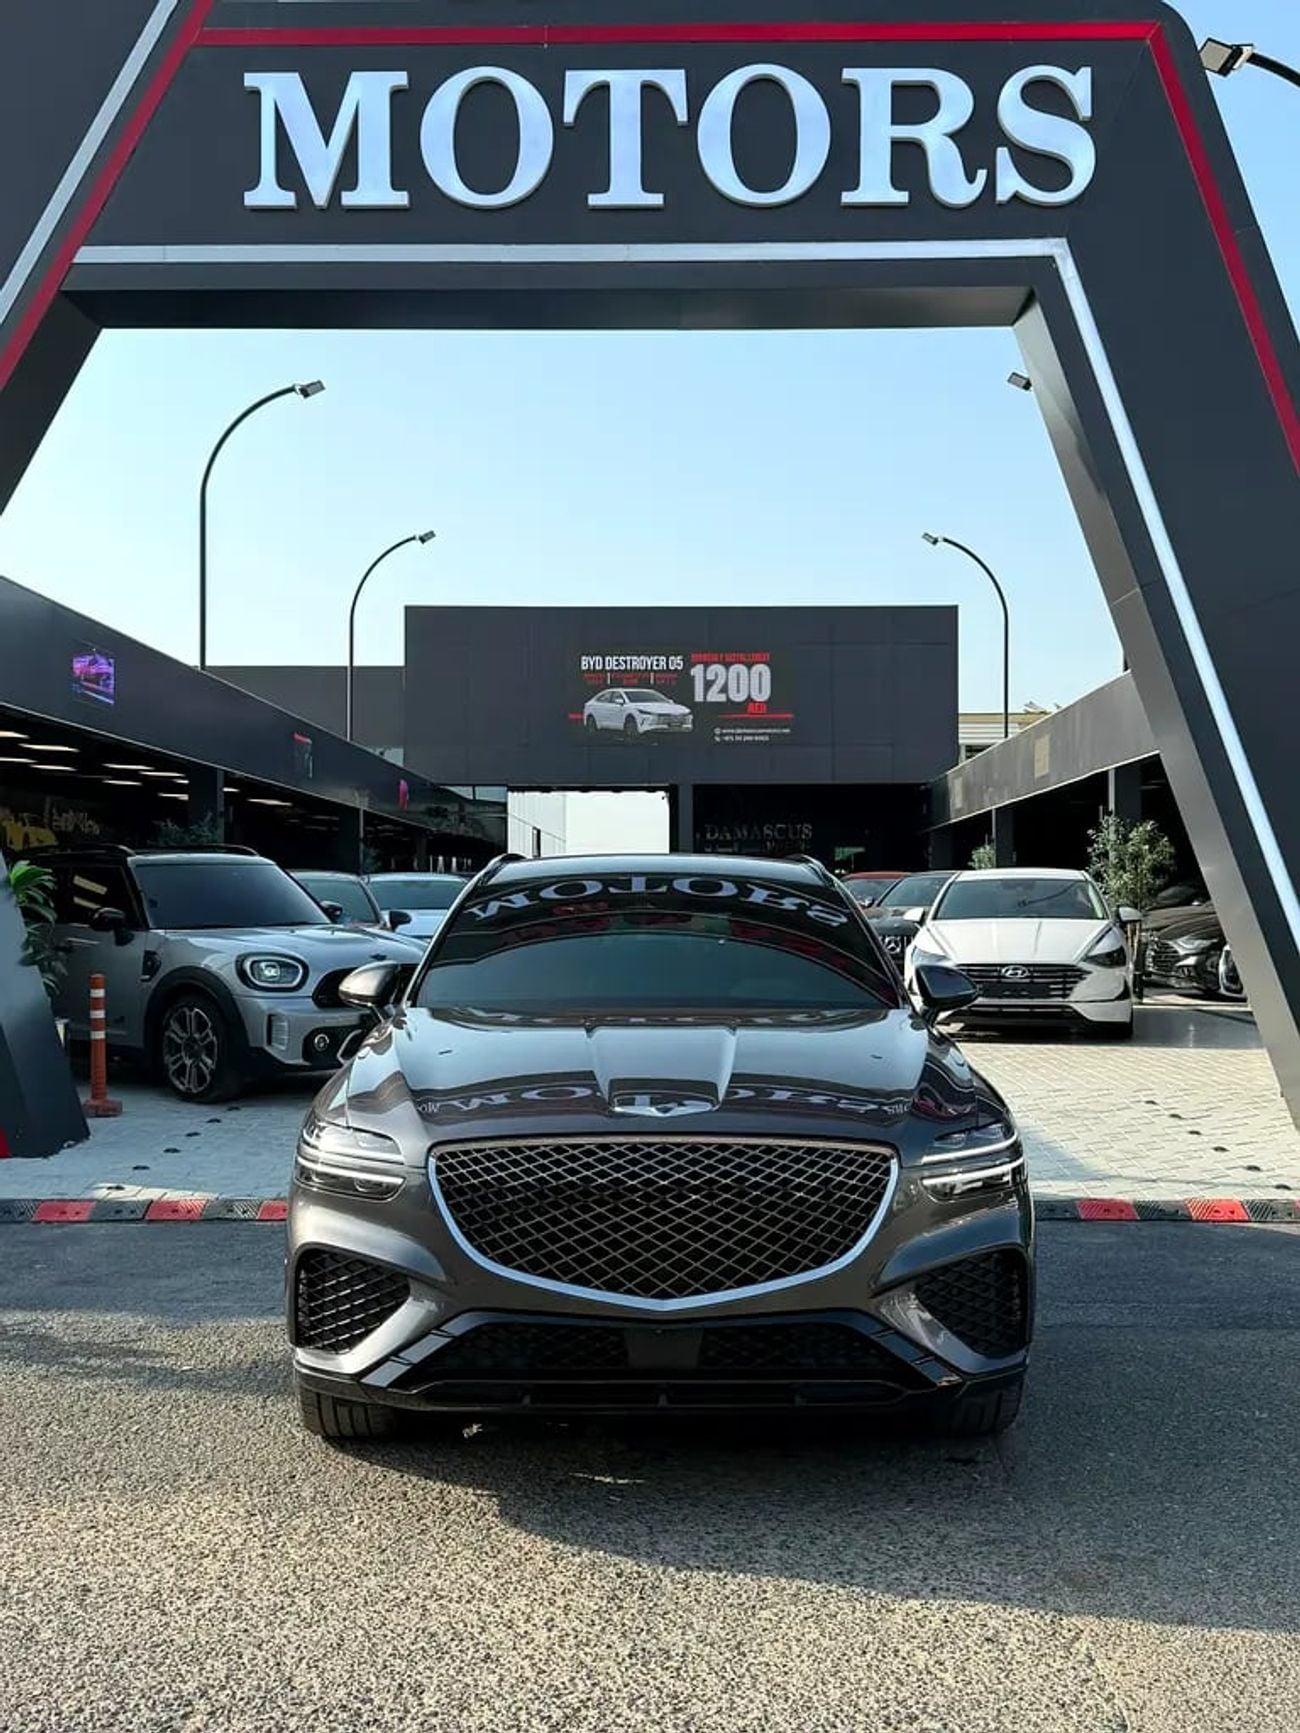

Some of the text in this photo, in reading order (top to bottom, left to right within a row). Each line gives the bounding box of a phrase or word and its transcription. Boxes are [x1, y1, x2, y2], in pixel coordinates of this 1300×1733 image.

[243, 63, 1097, 209] MOTORS
[580, 655, 604, 671] BYD
[604, 655, 667, 671] DESTROYER
[690, 663, 772, 703] 1200
[704, 823, 813, 840] DAMASCUS
